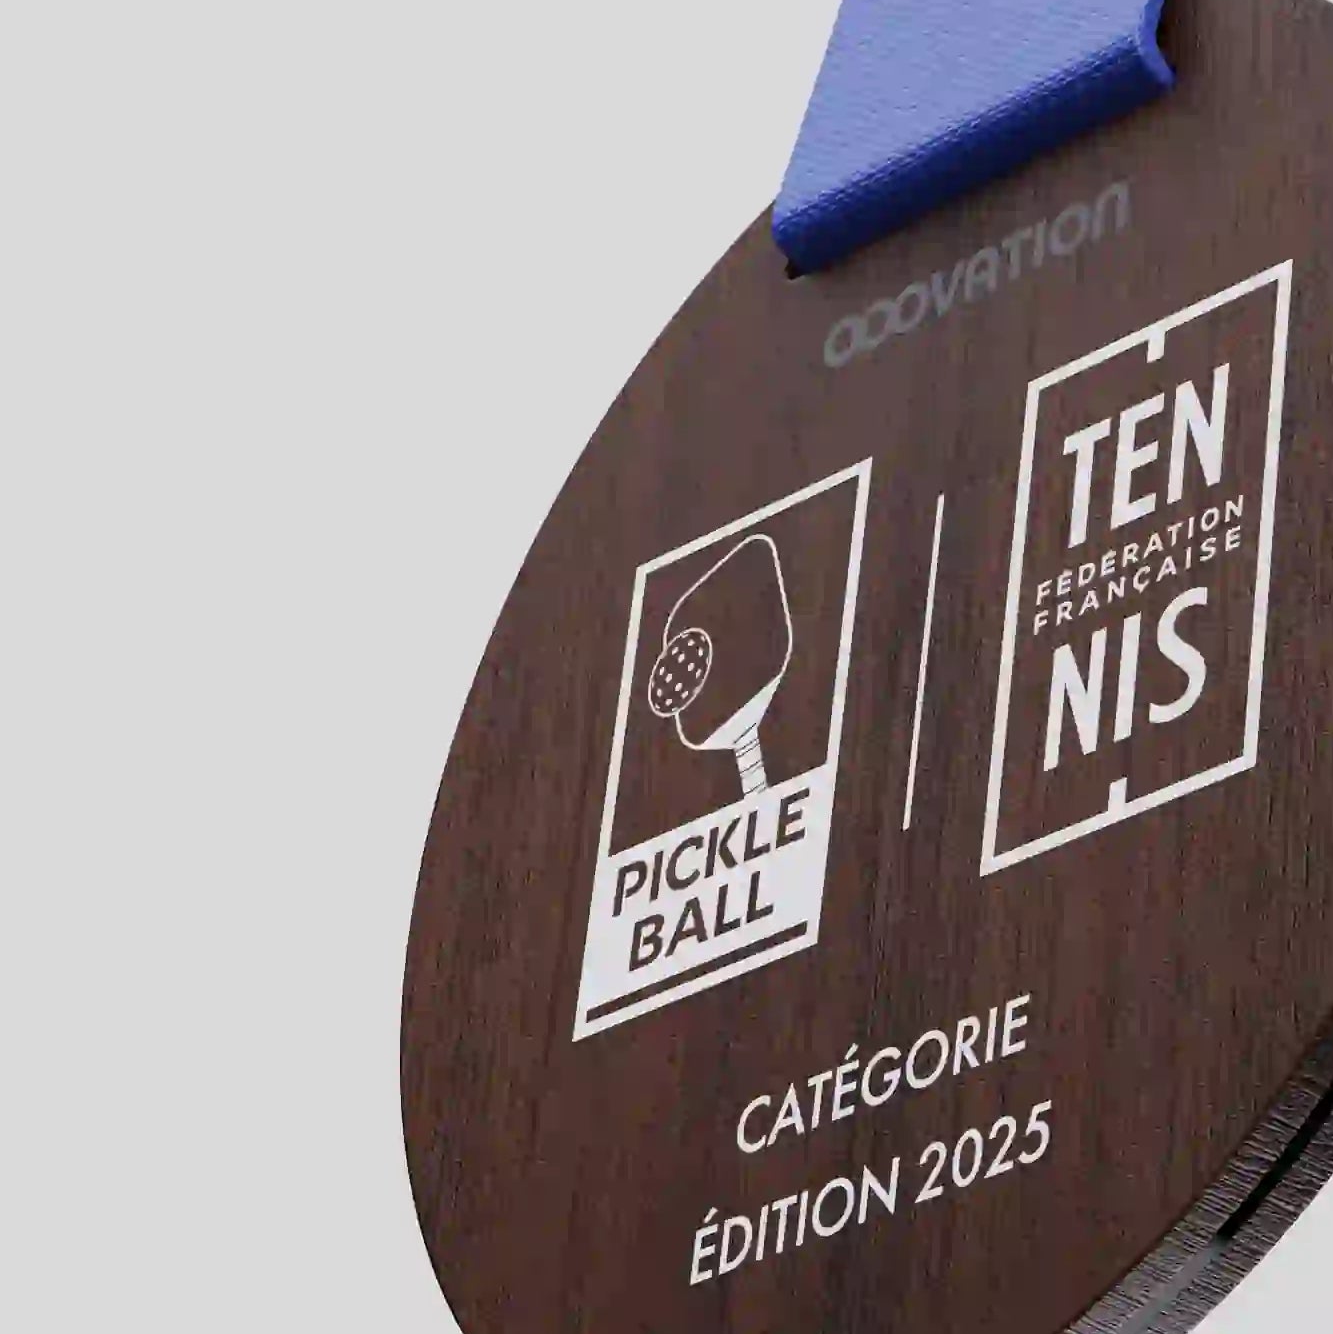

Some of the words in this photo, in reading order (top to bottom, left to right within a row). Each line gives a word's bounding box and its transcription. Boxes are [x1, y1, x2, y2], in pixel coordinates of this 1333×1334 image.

[1063, 363, 1229, 548] TEN
[1034, 525, 1240, 635] FRANÇAISE
[1036, 495, 1243, 605] FÉDÉRATION
[1044, 587, 1207, 771] NIS
[612, 785, 811, 917] PICKLE
[627, 869, 775, 972] BALL
[737, 995, 1029, 1152] CATÉGORIE
[691, 1158, 900, 1284] ÉDITION
[915, 1100, 1051, 1203] 2025
